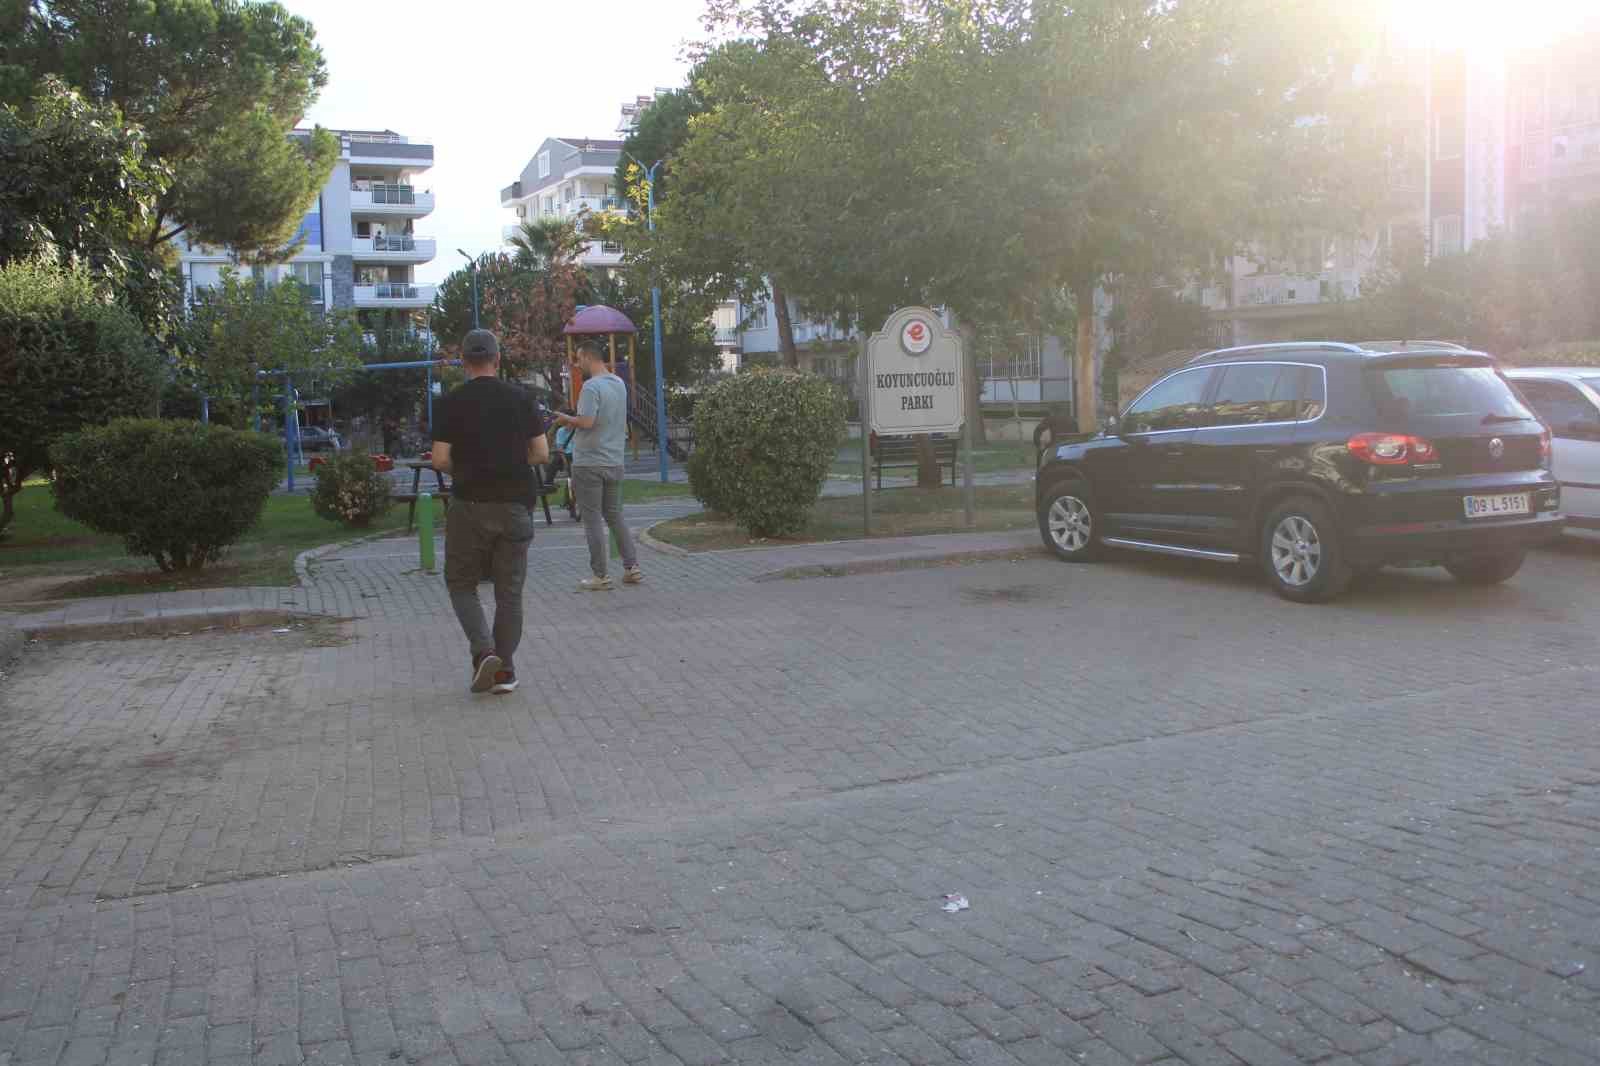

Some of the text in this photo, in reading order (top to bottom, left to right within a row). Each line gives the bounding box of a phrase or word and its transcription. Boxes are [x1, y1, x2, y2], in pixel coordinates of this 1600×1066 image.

[876, 369, 955, 388] KOYUNCUOĞLU
[901, 395, 934, 410] PARKI
[1502, 496, 1526, 511] 5151
